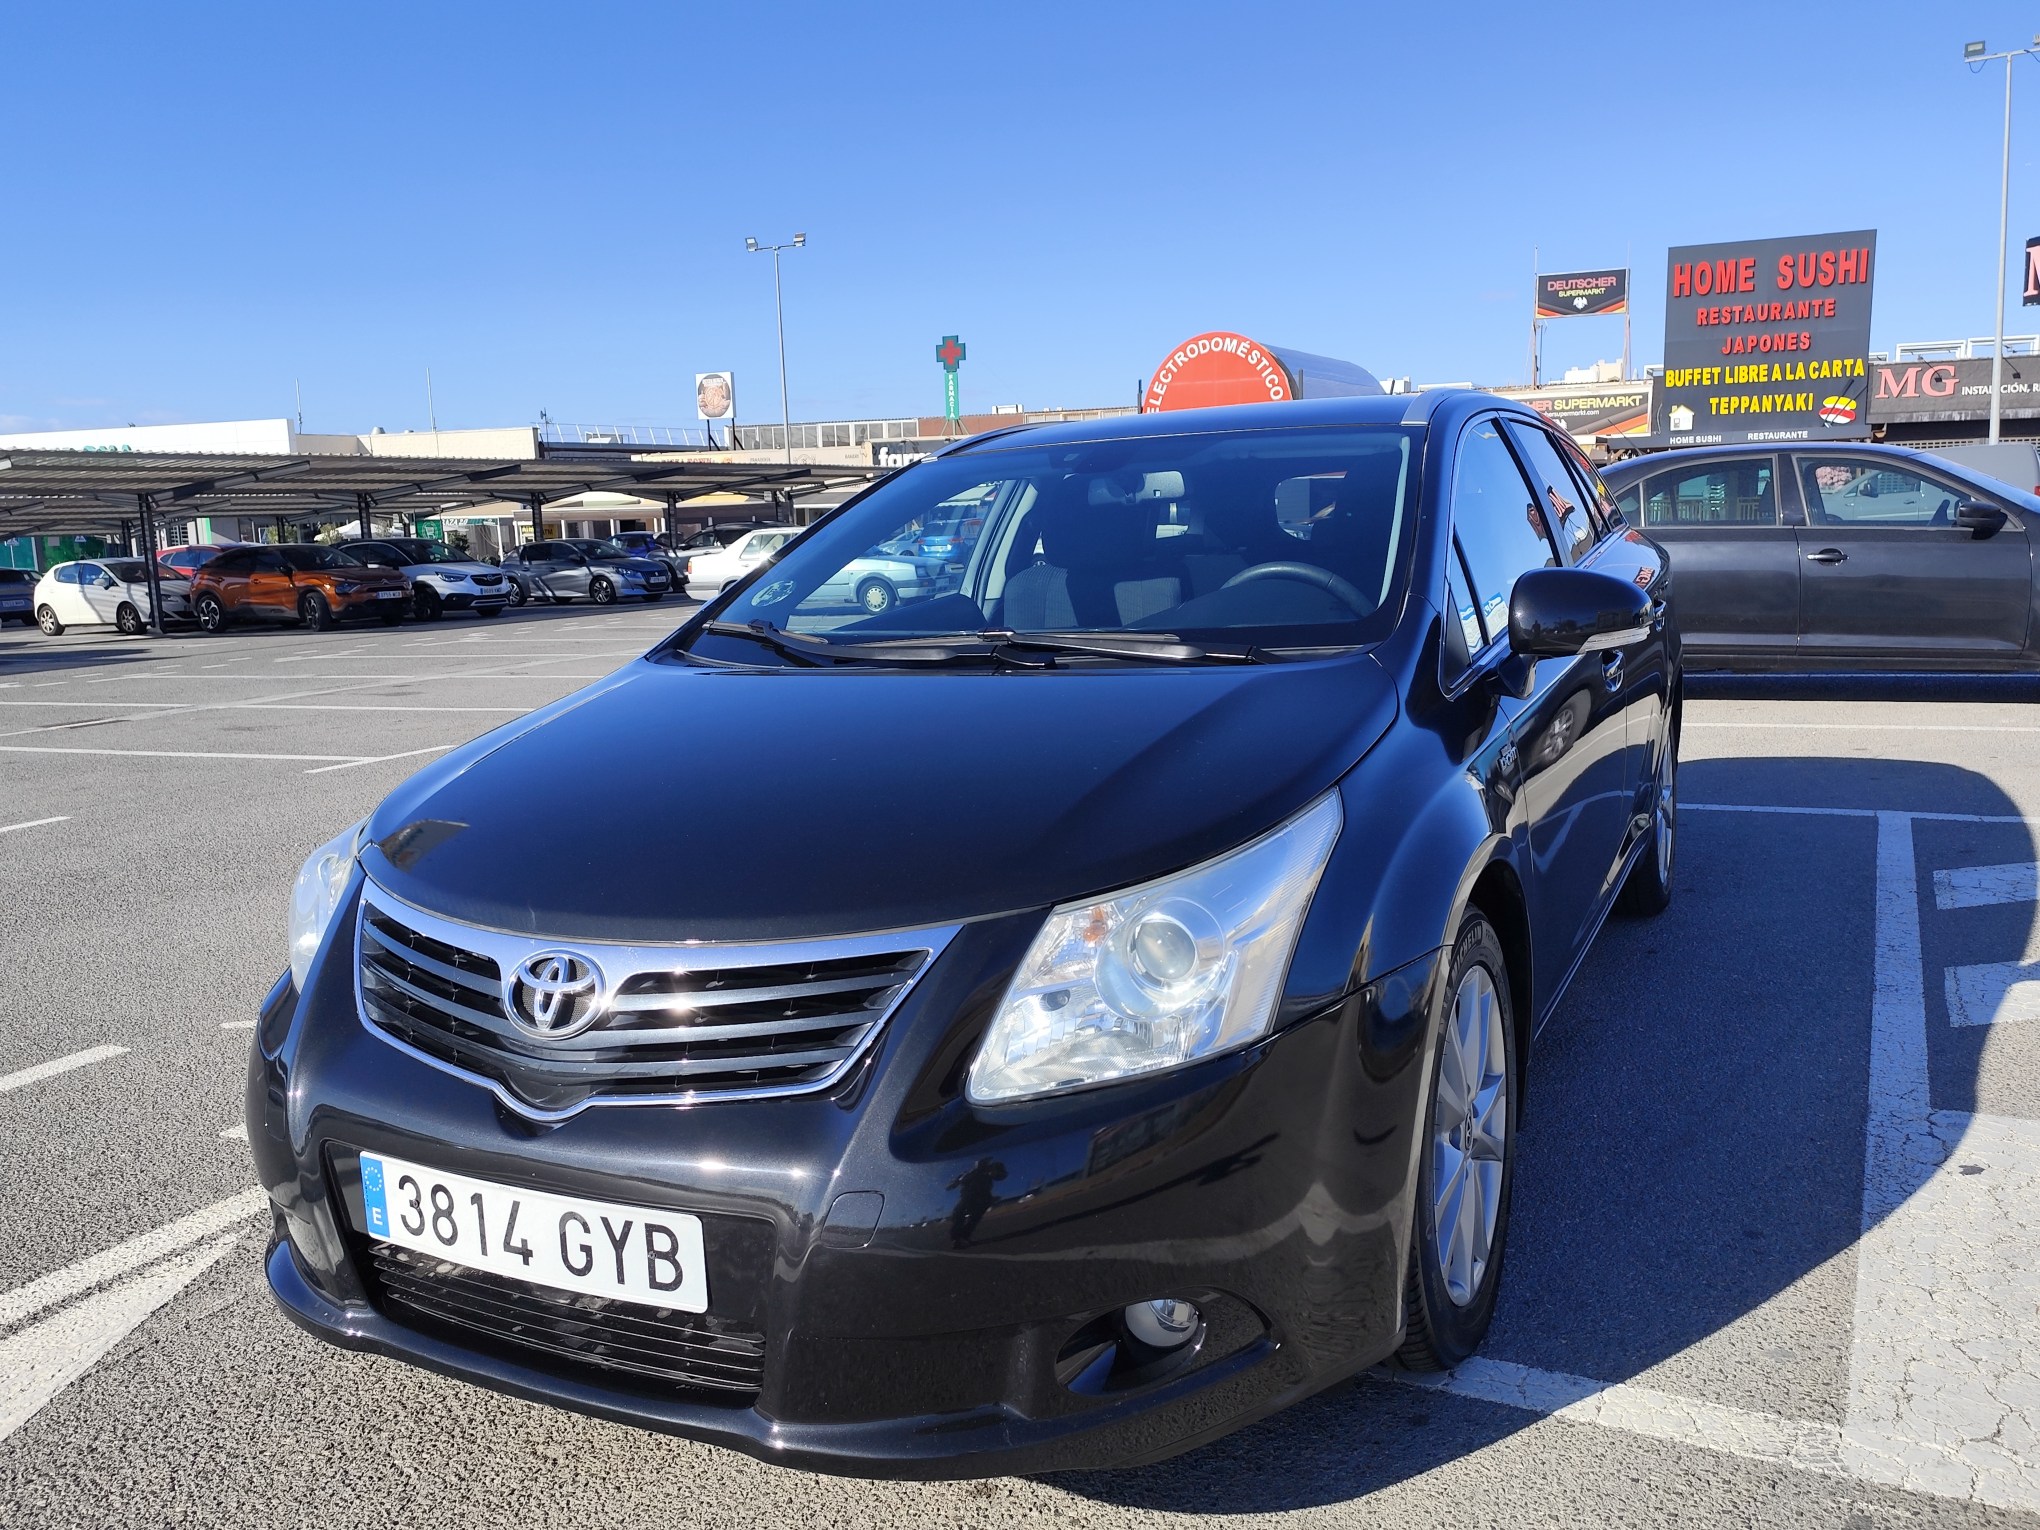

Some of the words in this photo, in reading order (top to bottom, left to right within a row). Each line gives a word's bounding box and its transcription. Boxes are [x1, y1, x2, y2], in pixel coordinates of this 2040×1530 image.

[1673, 257, 1756, 297] HOME
[1777, 248, 1869, 290] SUSHI
[1547, 276, 1617, 291] DEUTSCHER
[1558, 287, 1606, 297] SUPERMARKT
[1697, 298, 1836, 326] RESTAURANTE
[1721, 331, 1812, 355] JAPONES
[1665, 366, 1722, 388] BUFFET
[1725, 363, 1769, 384] LIBRE
[1771, 363, 1782, 381] A
[1785, 361, 1806, 381] LA
[1809, 358, 1865, 379] CARTA
[1874, 365, 1960, 399] MG
[1961, 383, 2030, 396] INSTALCIÓN,
[1554, 395, 1643, 410] SUPERMARKT
[1709, 392, 1814, 415] TEPPANYAKI
[1669, 436, 1695, 445] HOME
[1695, 435, 1722, 443] SUSHI
[1747, 430, 1809, 441] RESTAURANTE
[372, 1206, 384, 1226] E
[398, 1174, 534, 1266] 3814
[558, 1211, 684, 1292] GYB
